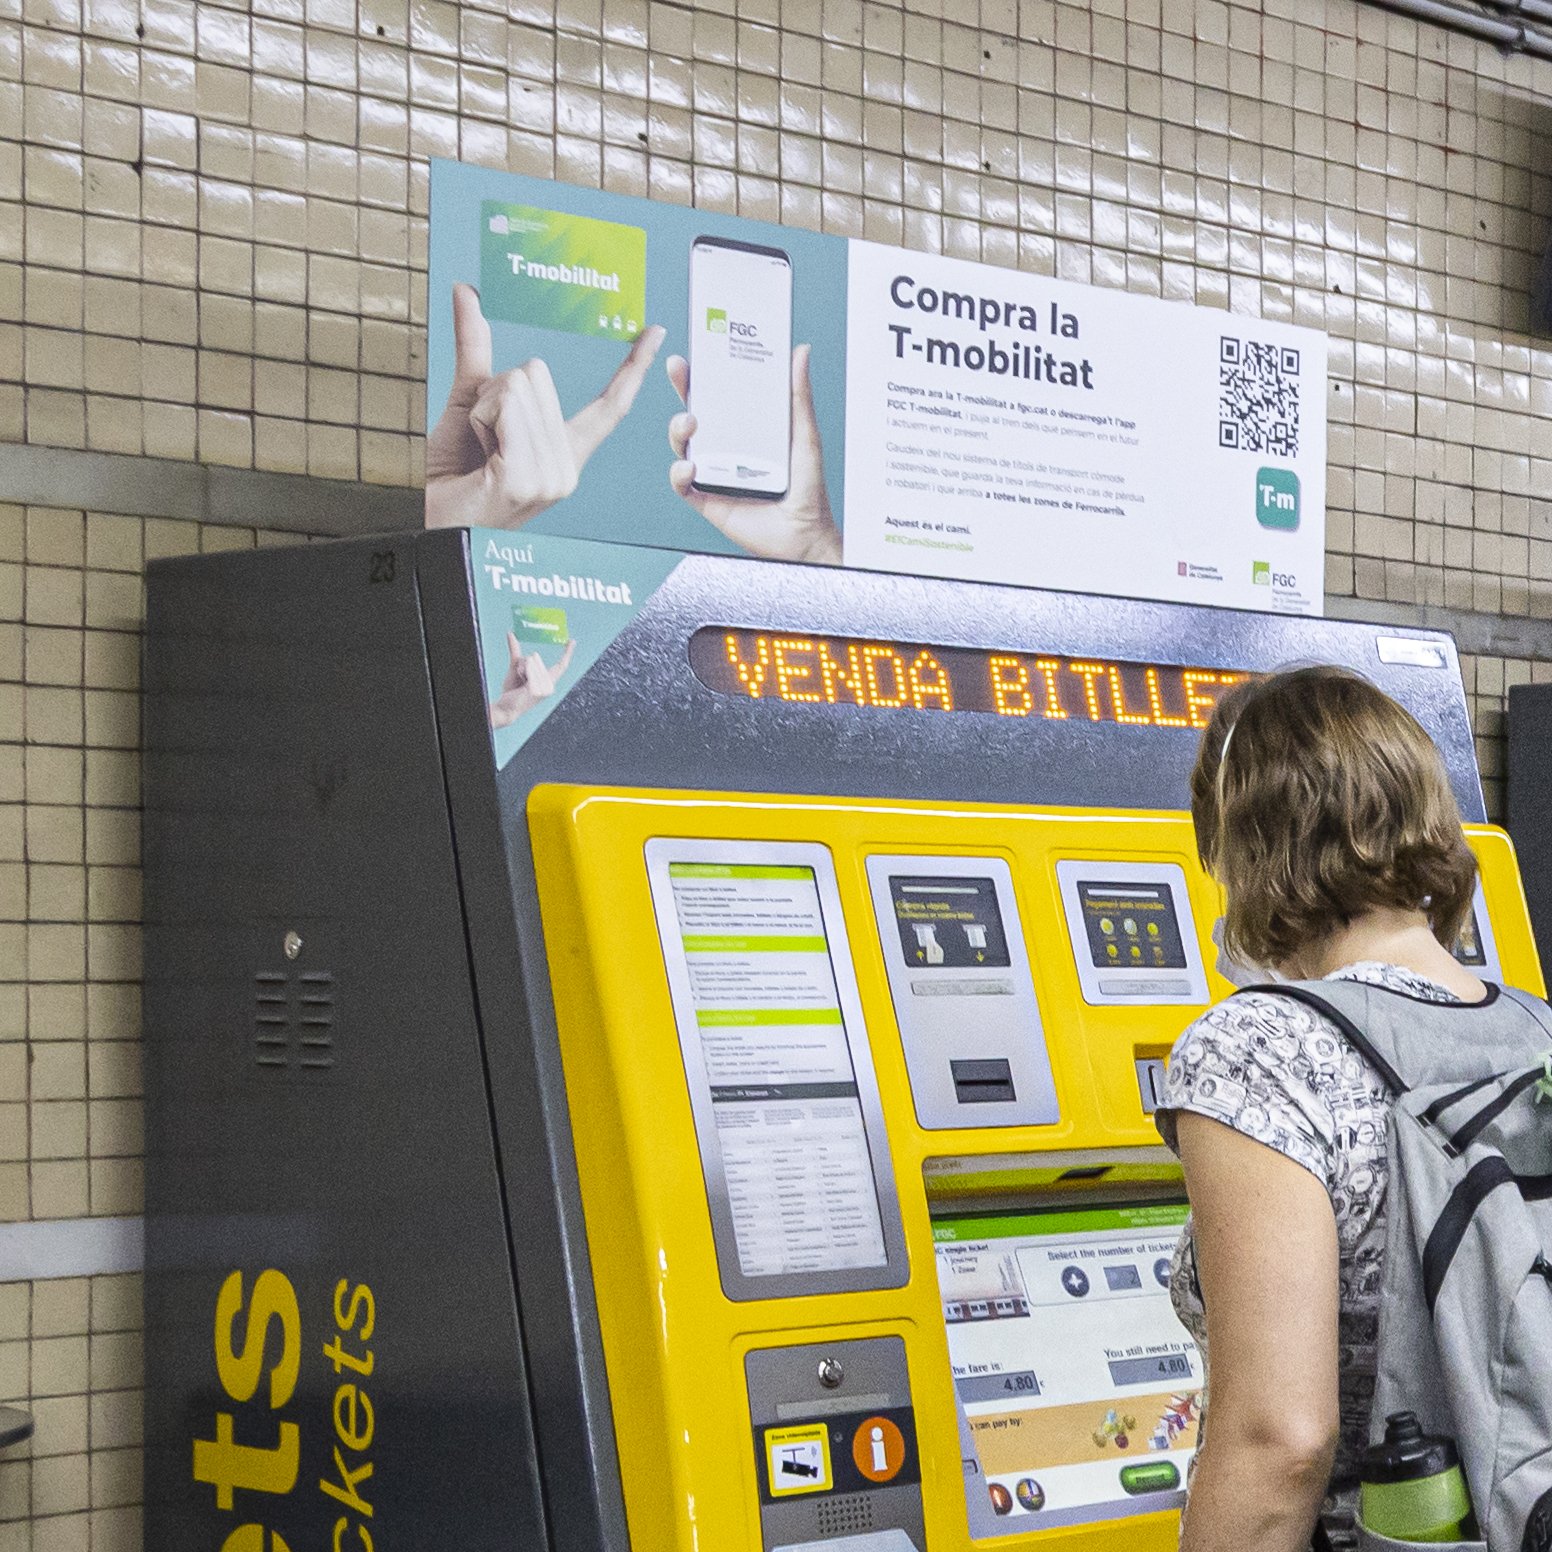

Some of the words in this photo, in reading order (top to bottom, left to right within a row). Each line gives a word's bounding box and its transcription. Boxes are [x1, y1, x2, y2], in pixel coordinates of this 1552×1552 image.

[507, 252, 620, 293] T-mobilitat
[890, 275, 1037, 332] Compra
[1050, 301, 1080, 340] la
[729, 321, 758, 339] FGC
[888, 324, 1095, 391] T-mobilitat
[887, 381, 926, 397] Compra
[927, 390, 944, 400] ara
[945, 390, 954, 401] la
[956, 391, 1007, 410] T-mobilitat
[1009, 402, 1015, 410] a
[1050, 408, 1056, 417] o
[887, 398, 907, 411] FGC
[985, 491, 991, 500] a
[993, 491, 1016, 503] totes
[1033, 496, 1060, 509] zones
[1061, 499, 1073, 511] de
[884, 515, 920, 530] Aquest
[935, 522, 944, 532] el
[484, 539, 535, 568] Aquí
[484, 564, 633, 606] T-mobilitat
[1272, 573, 1297, 588] FGC
[724, 635, 952, 712] VENDA
[1047, 1249, 1078, 1262] Select
[1080, 1248, 1096, 1259] the
[1097, 1245, 1135, 1257] number
[1136, 1242, 1146, 1254] of
[1104, 1347, 1124, 1359] You
[1126, 1345, 1144, 1357] still
[1146, 1343, 1169, 1355] need
[1170, 1342, 1181, 1353] to
[952, 1364, 966, 1375] he
[968, 1362, 988, 1374] fare
[1157, 1359, 1186, 1374] 4.80
[1003, 1375, 1034, 1392] 4.80
[993, 1419, 1009, 1430] pay
